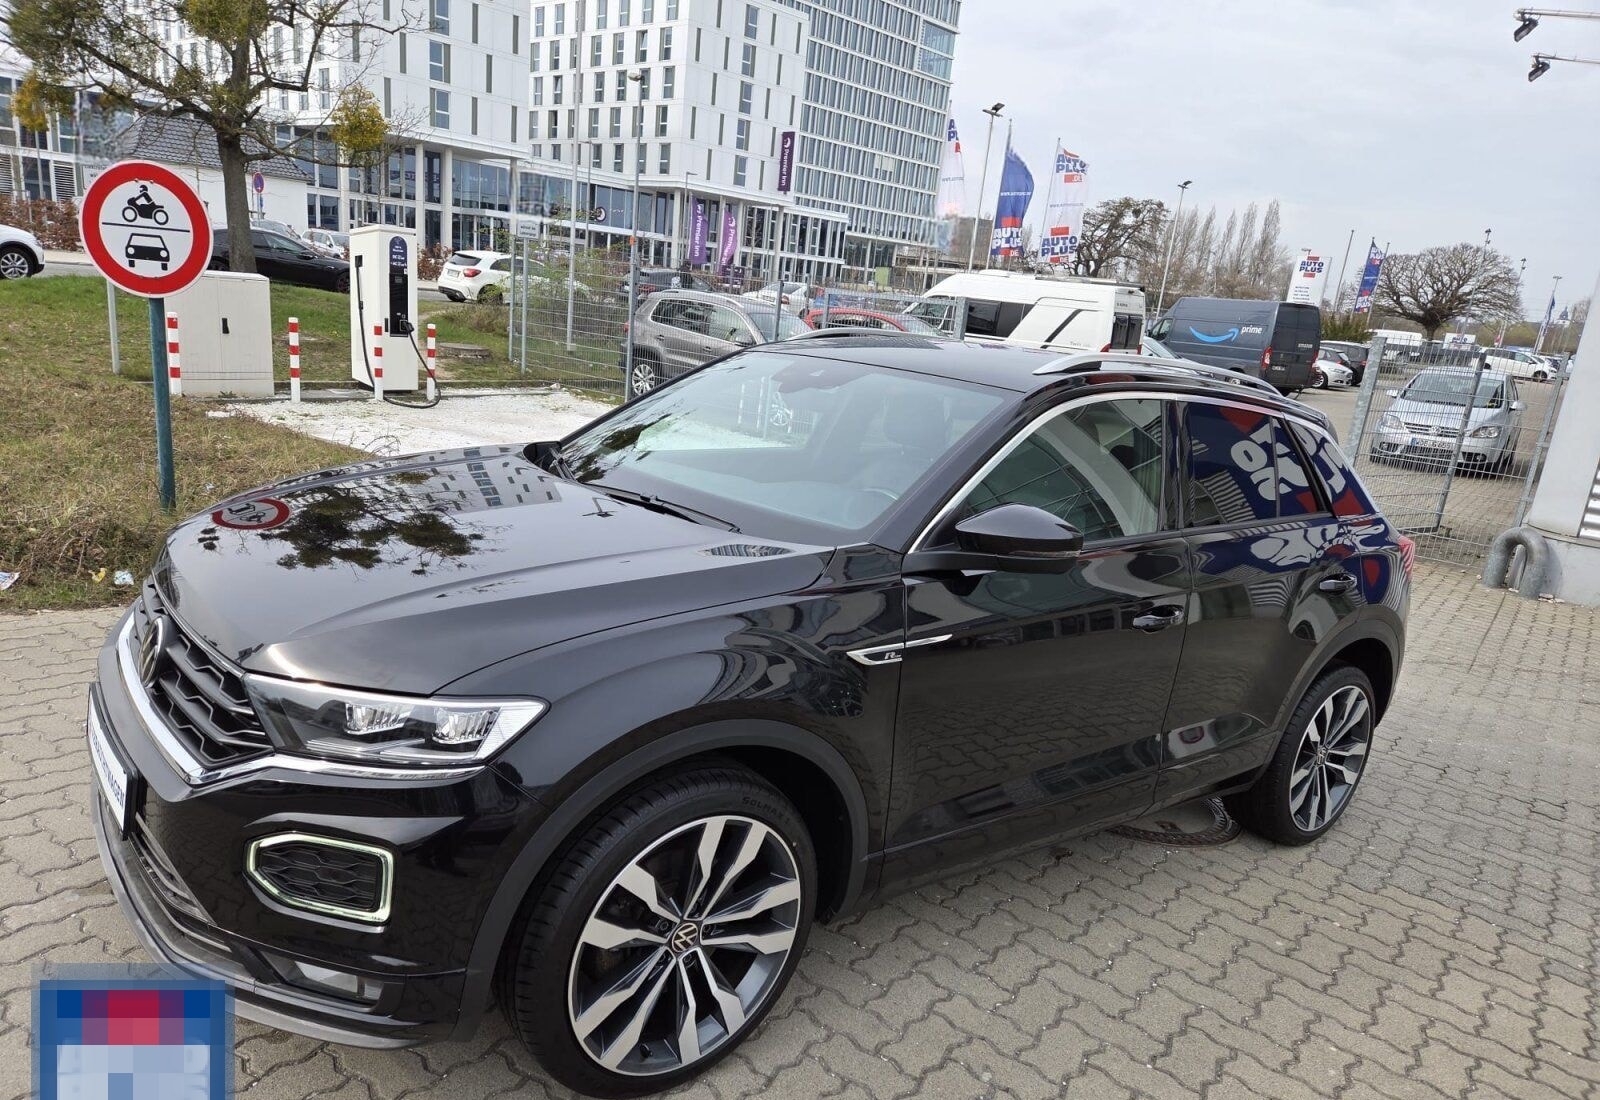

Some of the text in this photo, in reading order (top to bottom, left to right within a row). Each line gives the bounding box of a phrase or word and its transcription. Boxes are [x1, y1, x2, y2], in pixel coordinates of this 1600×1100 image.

[782, 149, 790, 175] Premier
[694, 215, 703, 244] Premier
[1042, 236, 1078, 247] AUTO
[1041, 246, 1078, 257] PLUS
[1300, 260, 1325, 268] AUTO
[1299, 266, 1324, 274] PLUS
[1241, 324, 1263, 335] prime
